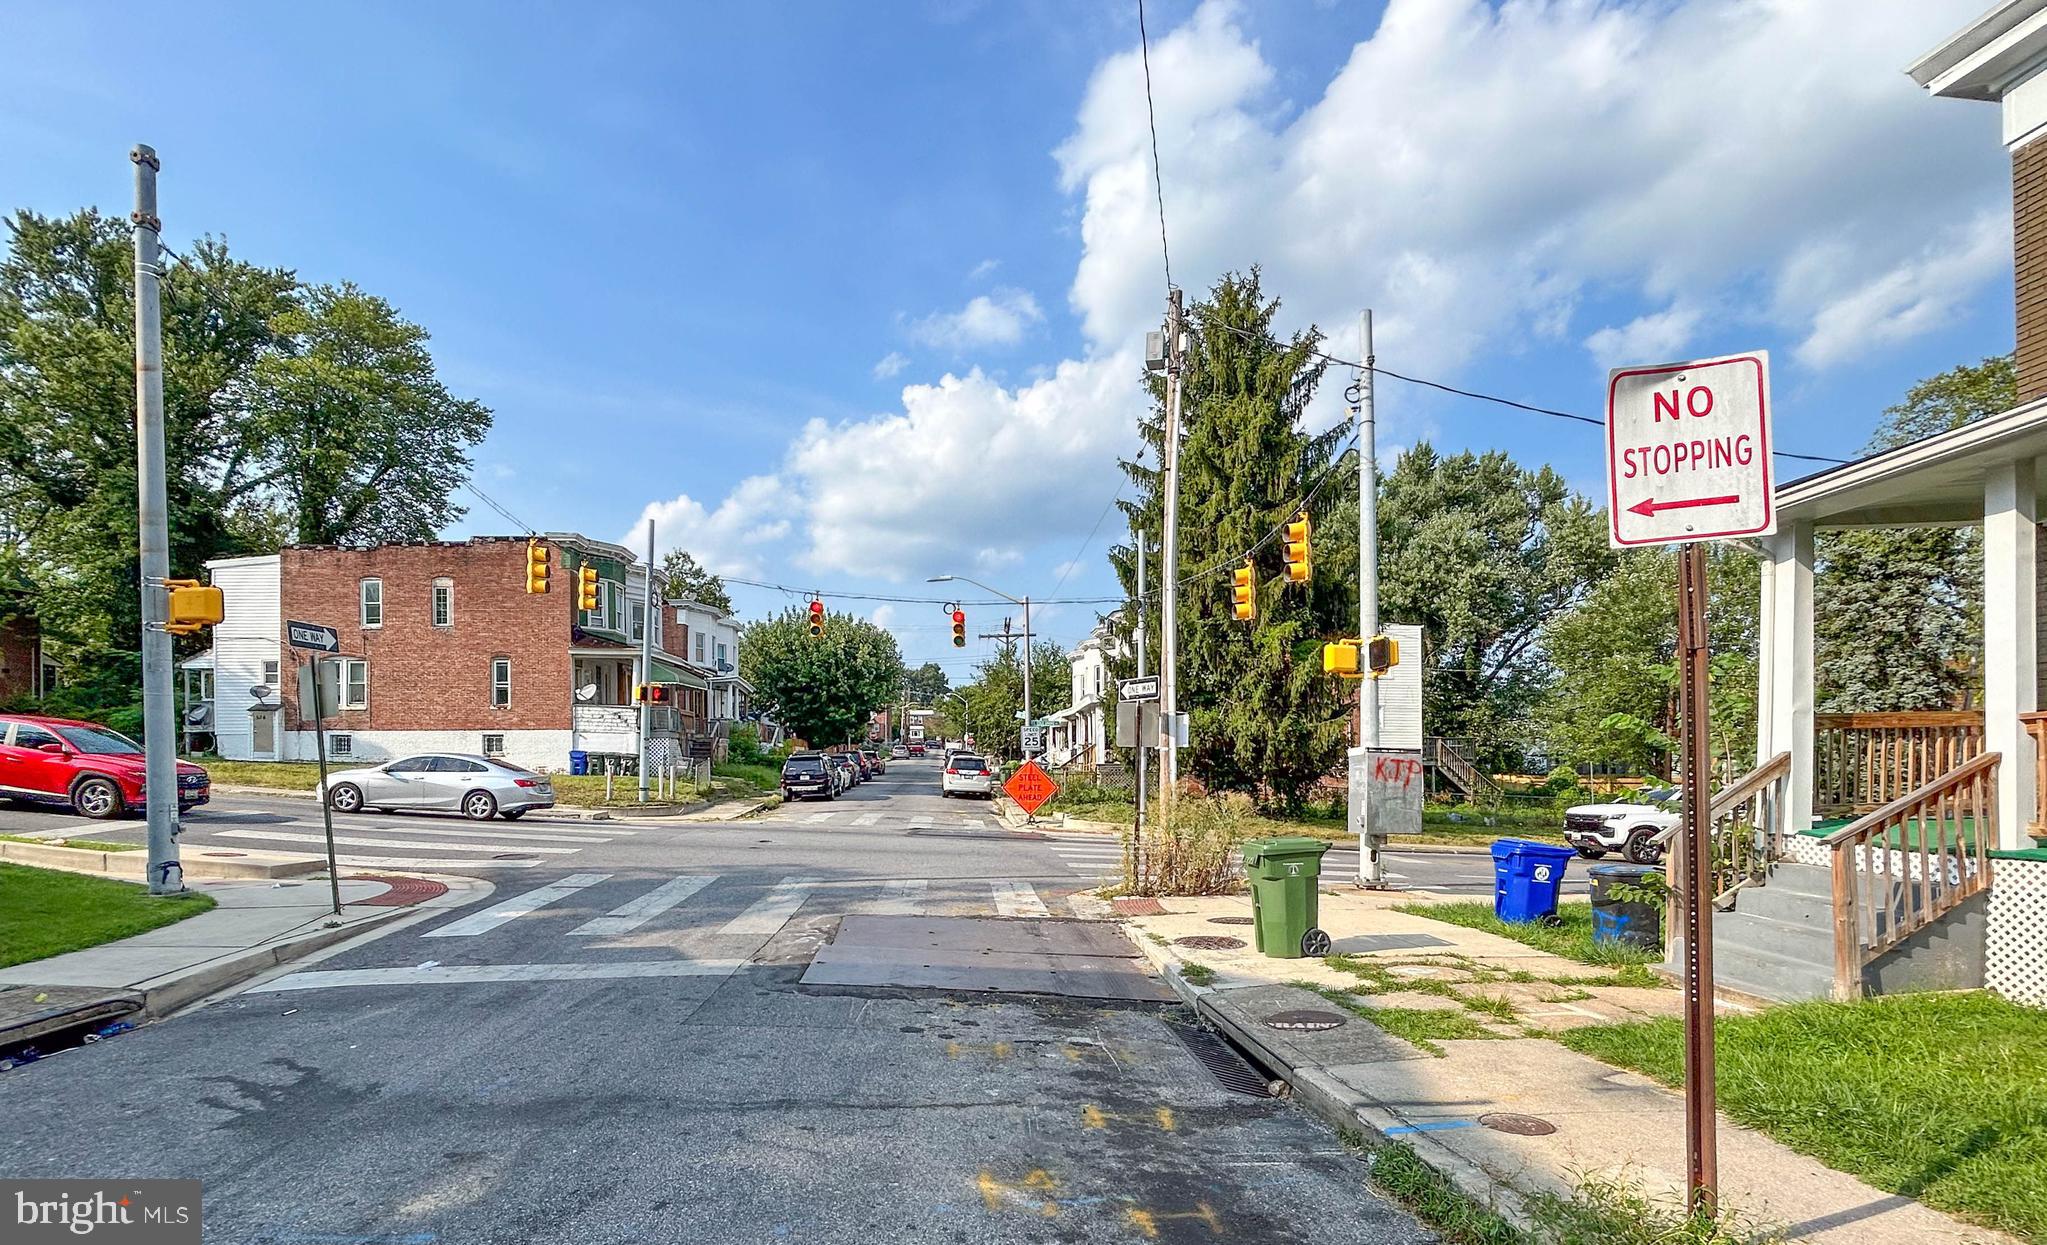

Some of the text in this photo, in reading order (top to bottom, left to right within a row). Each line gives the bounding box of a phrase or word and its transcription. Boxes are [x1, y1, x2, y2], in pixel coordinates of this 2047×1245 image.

[1653, 386, 1713, 422] NO
[1623, 434, 1752, 479] STOPPING
[293, 629, 324, 643] ONE WAY
[1127, 686, 1139, 694] ONE
[1024, 737, 1039, 746] 25
[1018, 773, 1041, 781] STEEL
[1375, 757, 1422, 787] KTP
